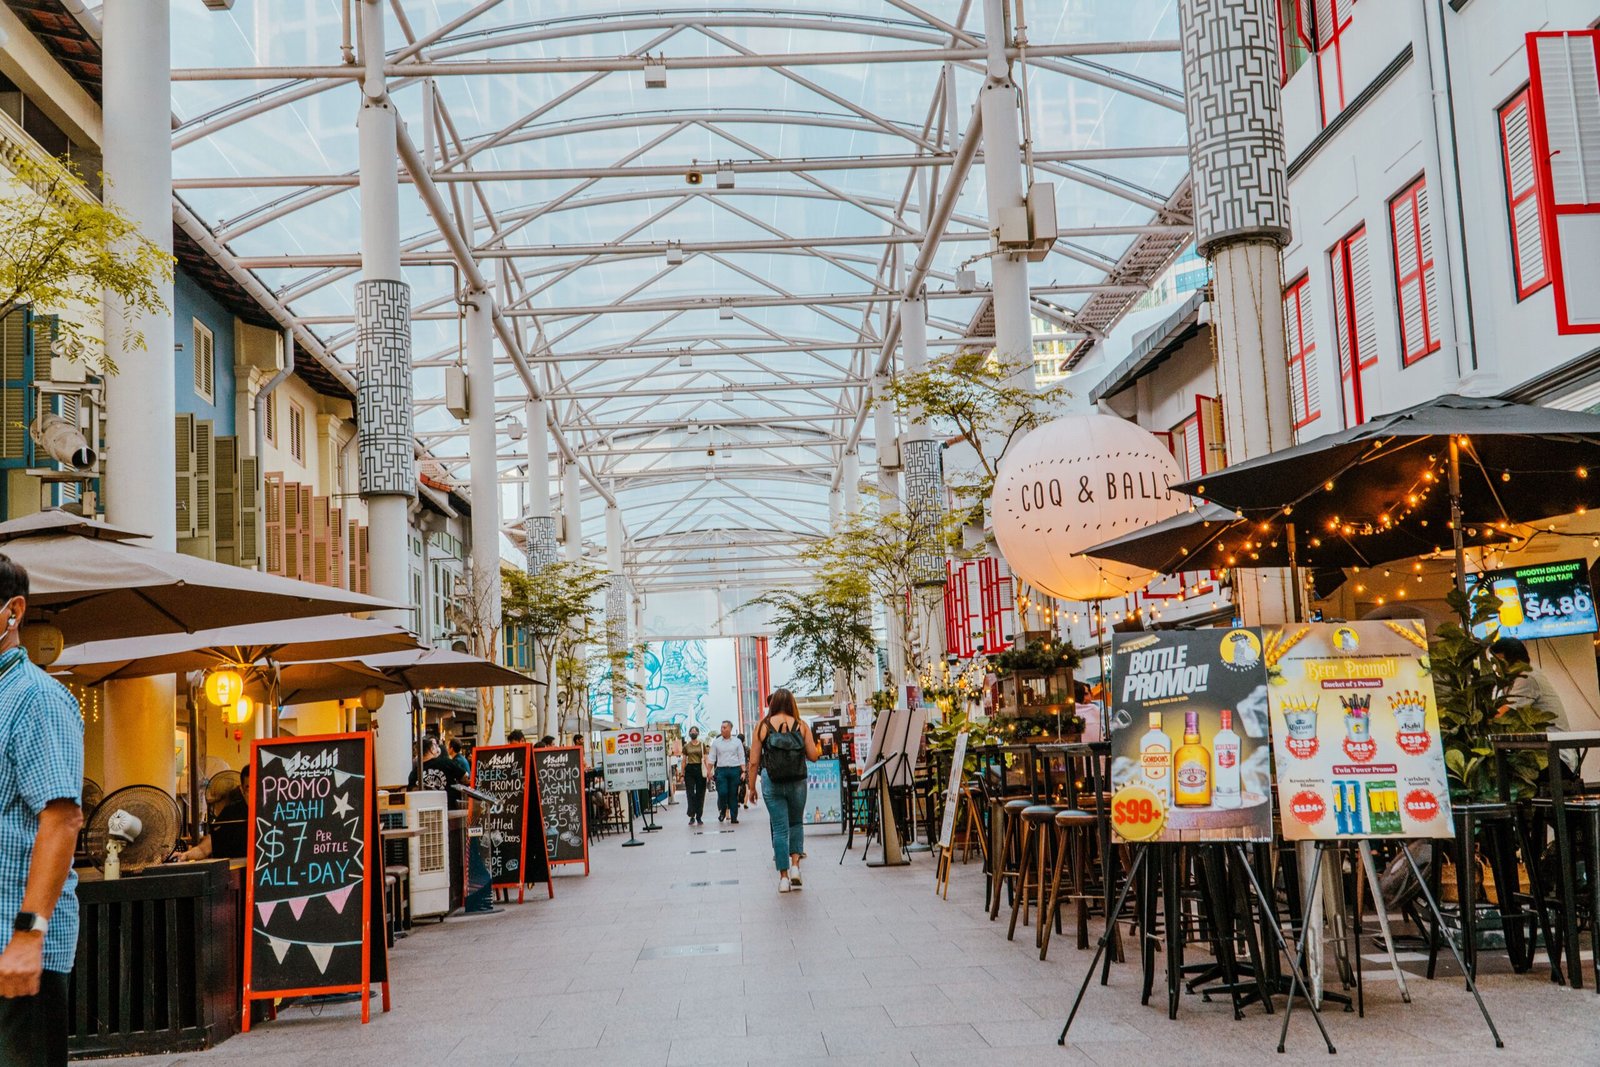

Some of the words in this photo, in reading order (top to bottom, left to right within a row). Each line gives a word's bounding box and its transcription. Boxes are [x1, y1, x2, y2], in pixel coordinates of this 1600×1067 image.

[1021, 478, 1063, 512] COQ
[1077, 475, 1094, 504] &
[1106, 472, 1172, 501] BALLS
[1516, 568, 1546, 578] SMOOTH
[1546, 563, 1580, 574] DRAUGHT
[1527, 577, 1545, 585] NOW
[1556, 573, 1574, 581] TAP!
[1525, 595, 1591, 621] $4.80
[1129, 645, 1188, 675] BOTTLE
[1306, 660, 1338, 680] Beer
[1122, 663, 1210, 703] PROMO!!
[1323, 681, 1345, 689] Bucket
[1358, 680, 1381, 688] Promo!
[1401, 722, 1421, 730] Asahi
[617, 732, 642, 744] 20
[644, 734, 663, 743] 20
[1400, 735, 1427, 744] $39+
[1289, 740, 1316, 749] $39+
[284, 747, 339, 771] Asahi
[489, 752, 515, 766] Asahi
[543, 753, 569, 765] Asahi
[293, 769, 332, 779] アサヒビール
[539, 766, 580, 784] PROMO
[1372, 765, 1396, 773] Promo!
[478, 769, 508, 782] BEERS
[490, 779, 521, 791] PROMO
[541, 781, 578, 797] ASAHI
[262, 776, 331, 807] PROMO
[273, 799, 324, 821] ASAHI
[506, 804, 519, 815] for
[549, 805, 556, 813] 2
[1114, 798, 1161, 826] $99+
[569, 822, 581, 834] DAY
[263, 821, 308, 864] $7
[315, 829, 332, 842] PER
[313, 842, 349, 854] BOTTLE
[485, 857, 502, 868] SDE
[260, 859, 350, 886] ALL-DAY
